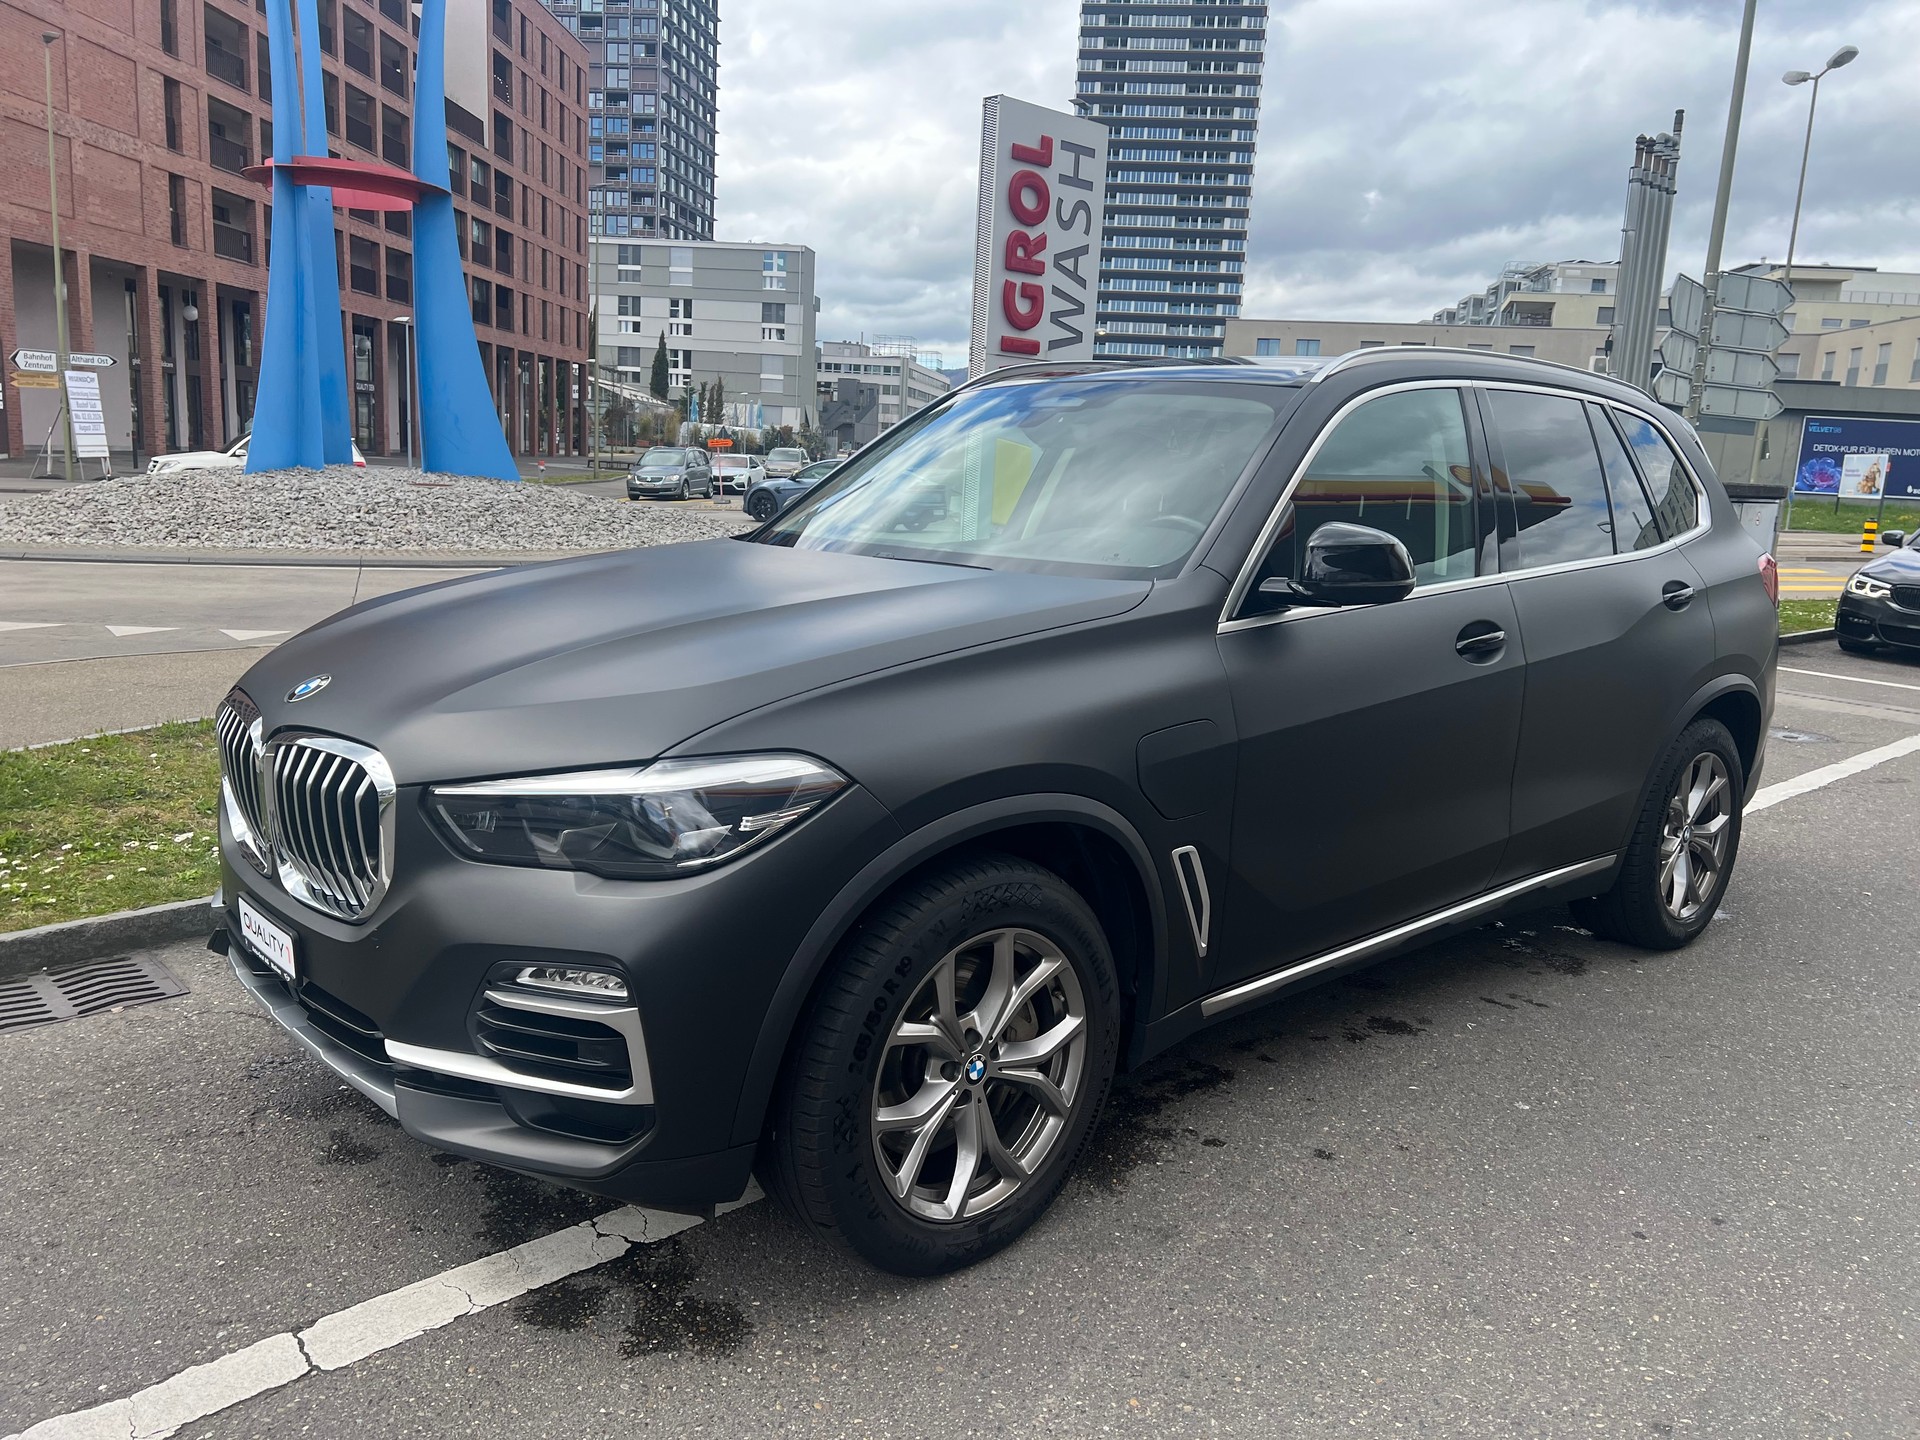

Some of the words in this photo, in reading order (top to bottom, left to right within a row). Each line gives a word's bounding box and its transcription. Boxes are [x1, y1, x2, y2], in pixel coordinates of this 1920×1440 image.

[1000, 134, 1053, 358] IGROL
[1048, 139, 1096, 351] WASH
[24, 353, 52, 361] Bahnhof
[72, 356, 95, 364] Althard
[24, 361, 54, 370] Zentrum
[1813, 443, 1858, 454] DETOX-KUR
[1859, 445, 1877, 455] FÜR
[1877, 447, 1901, 456] IHREN
[848, 996, 888, 1075] 265/50
[882, 977, 900, 996] R
[894, 955, 913, 979] 19
